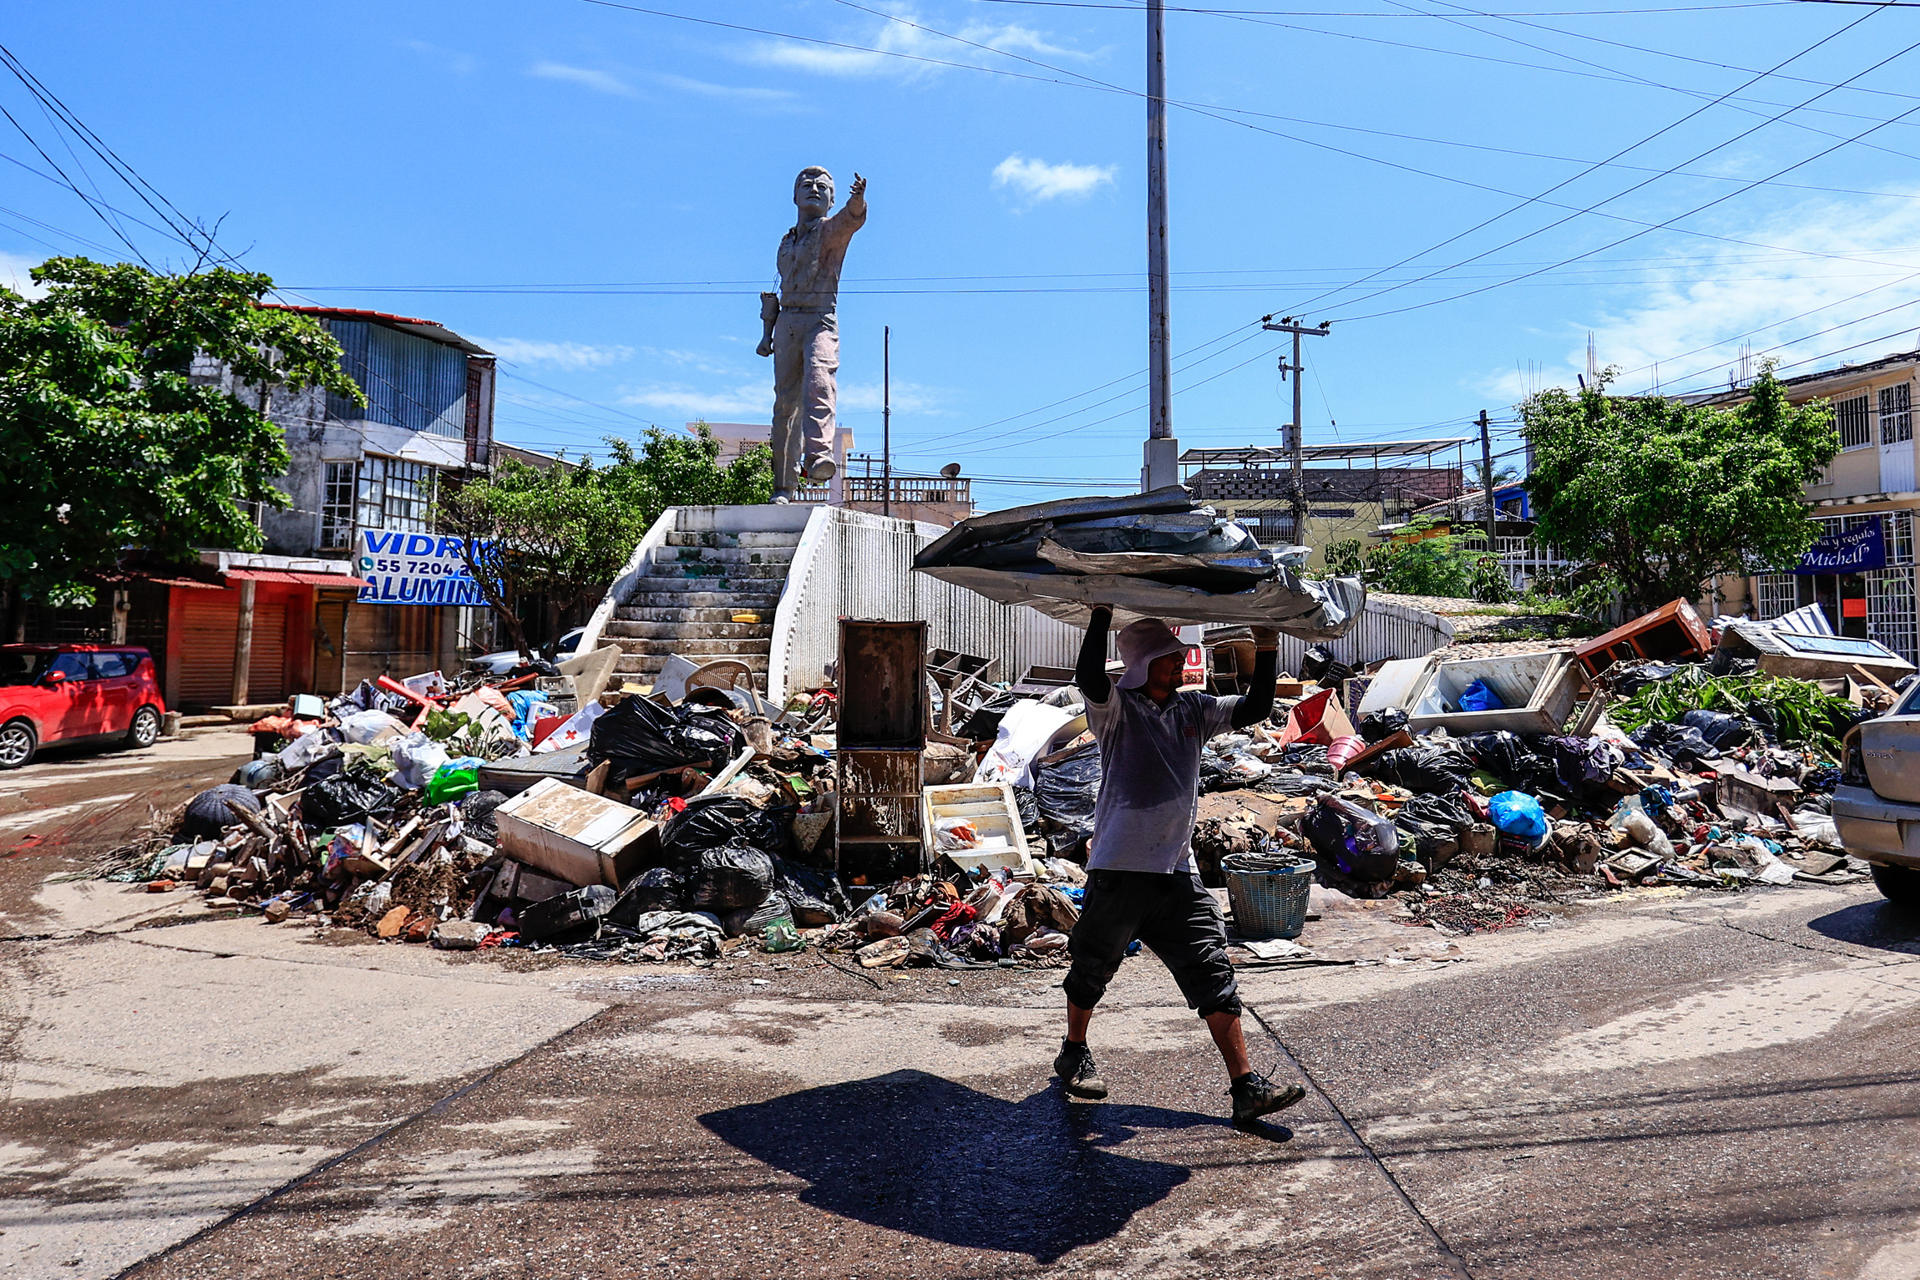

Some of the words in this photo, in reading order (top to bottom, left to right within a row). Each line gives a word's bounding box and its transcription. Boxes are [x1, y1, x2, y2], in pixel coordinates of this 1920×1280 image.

[1832, 538, 1840, 549] y
[377, 559, 400, 573] 55
[407, 561, 453, 577] 7204
